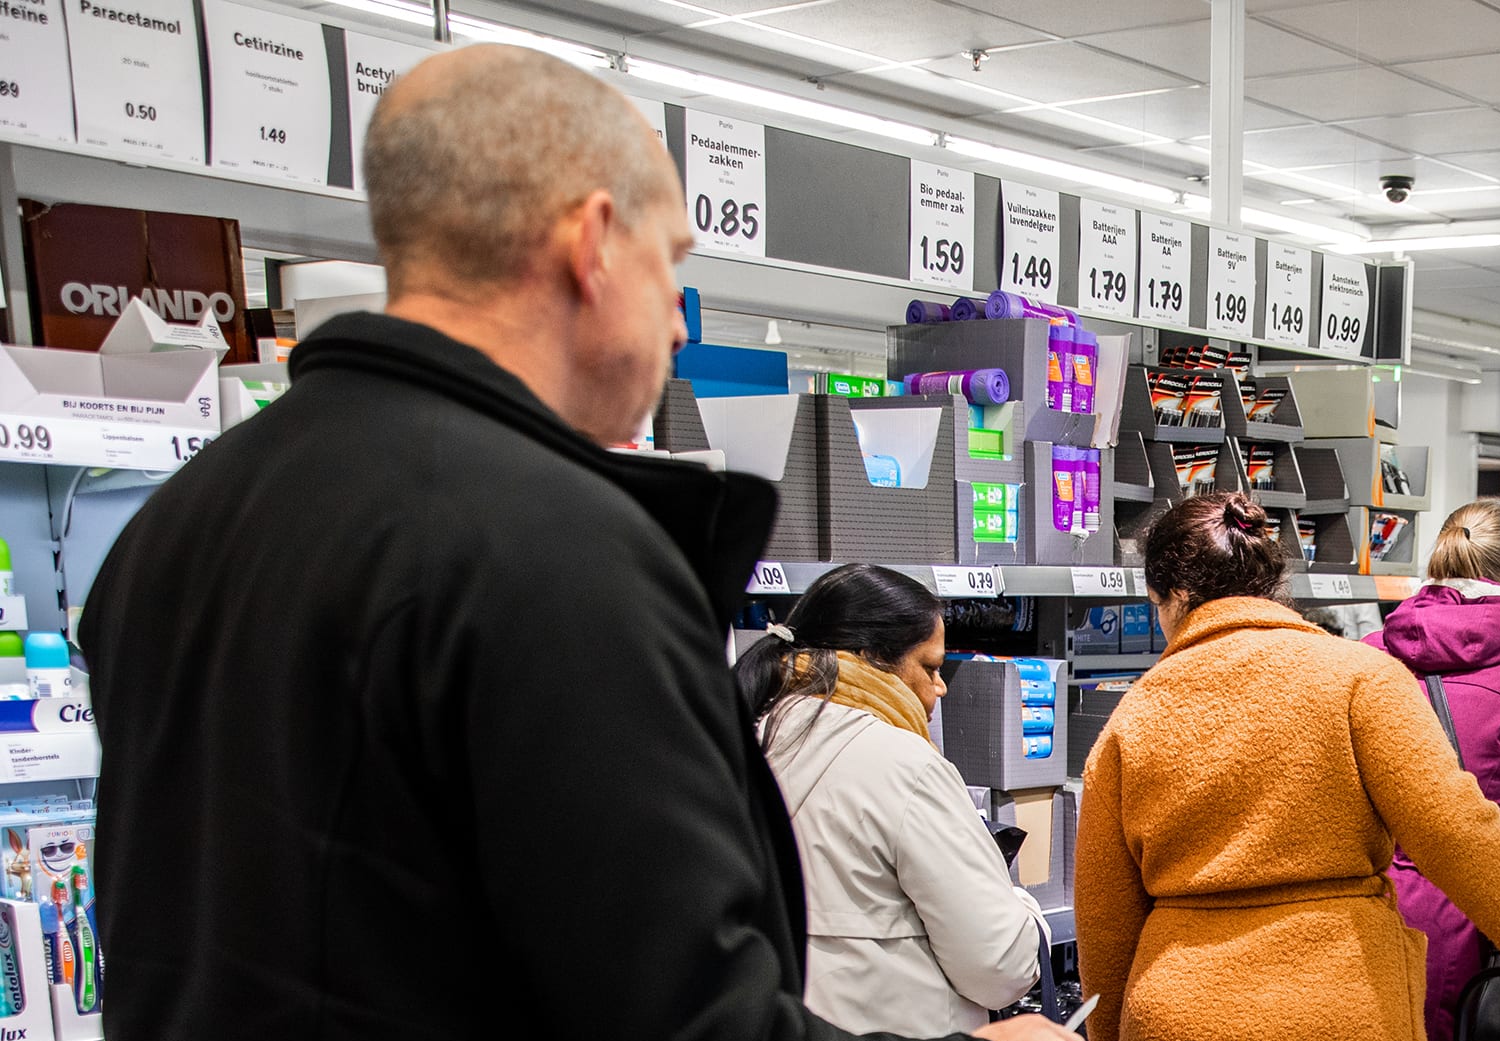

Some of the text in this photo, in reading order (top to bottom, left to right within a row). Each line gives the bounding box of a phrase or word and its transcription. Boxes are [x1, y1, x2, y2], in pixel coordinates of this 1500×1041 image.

[80, 0, 182, 35] Paracetamol
[233, 32, 304, 61] Cetirizine
[125, 102, 157, 121] 0.50
[259, 126, 286, 144] 1.49
[691, 134, 761, 158] Pedaalemmer-
[709, 155, 744, 169] zakken
[920, 183, 966, 201] Bio pedaal-
[920, 198, 965, 214] emmer zak
[1007, 202, 1057, 221] Vuilniszakken
[695, 193, 760, 240] 0.85
[1009, 214, 1055, 233] lavendelgeur
[1092, 220, 1127, 237] Batterijen
[1102, 234, 1117, 245] AAA
[1151, 232, 1183, 249] Batterijen
[920, 235, 964, 275] 1.59
[1162, 246, 1172, 256] AA
[1217, 247, 1247, 263] Batterijen
[1012, 252, 1052, 290] 1.49
[1227, 260, 1237, 271] 9V
[1275, 260, 1303, 275] Batterijen
[1089, 267, 1127, 303] 1.79
[1286, 273, 1292, 282] C
[1331, 273, 1360, 287] Aansteker
[1147, 277, 1183, 312] 1.79
[1328, 284, 1365, 298] elektronisch
[1214, 291, 1247, 324] 1.99
[1271, 302, 1304, 335] 1.49
[1327, 313, 1361, 344] 0.99
[1159, 378, 1187, 389] AEROCELL
[63, 400, 165, 416] BIJ KOORTS EN BIJ PIJN
[967, 571, 993, 589] 0.79
[1100, 571, 1124, 588] 0.59
[59, 704, 95, 723] Cie
